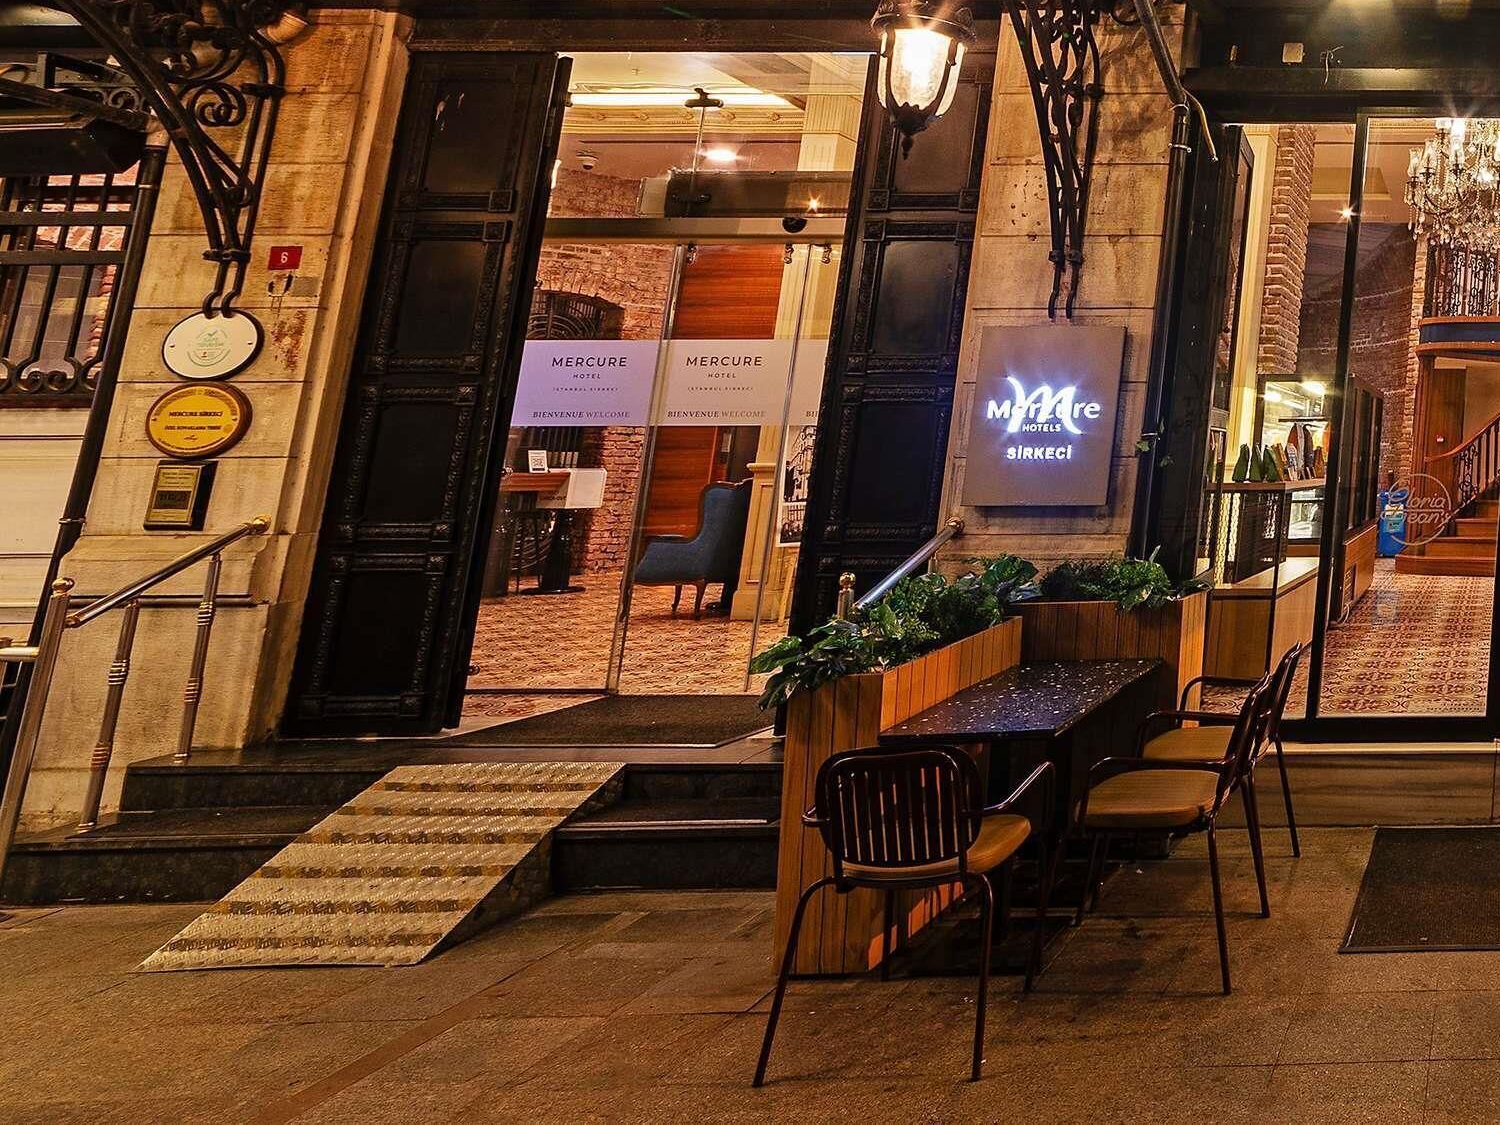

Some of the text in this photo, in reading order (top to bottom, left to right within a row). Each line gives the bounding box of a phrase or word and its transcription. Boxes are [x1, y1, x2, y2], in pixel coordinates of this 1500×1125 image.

[280, 251, 289, 264] 6
[552, 356, 628, 367] MERCURE
[686, 356, 763, 366] MERCURE
[532, 411, 630, 419] BIENVENUE WELCOME
[667, 410, 765, 418] BIENVENUE WELCOME
[1022, 423, 1062, 432] HOTELS
[1006, 443, 1072, 460] SİRKECİ
